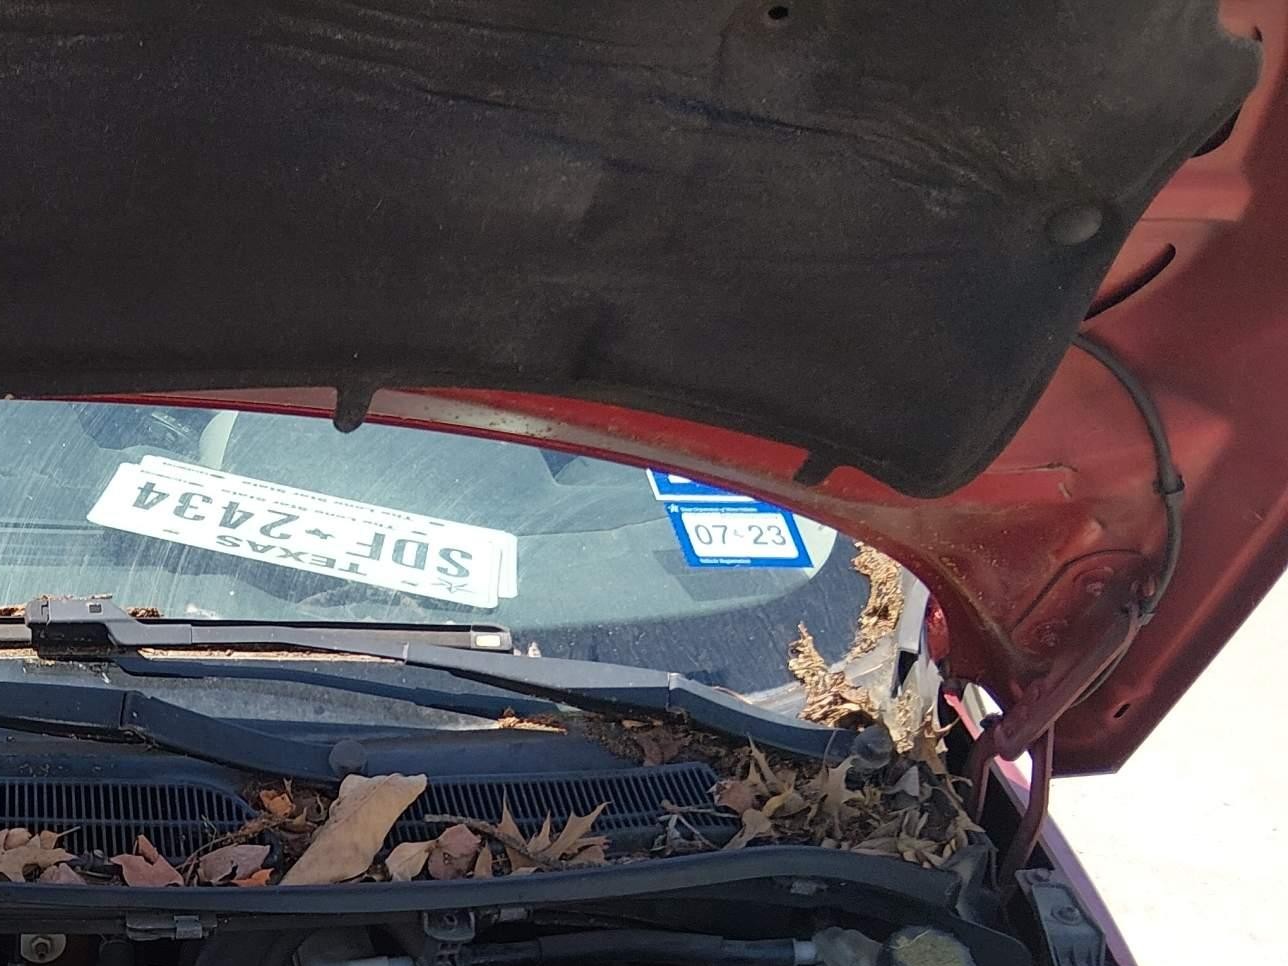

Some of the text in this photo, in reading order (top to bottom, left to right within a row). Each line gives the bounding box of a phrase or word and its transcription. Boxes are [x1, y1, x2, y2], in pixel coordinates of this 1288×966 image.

[132, 481, 473, 578] SDF 2434
[694, 524, 787, 546] 07 23
[215, 534, 367, 576] TEXAS
